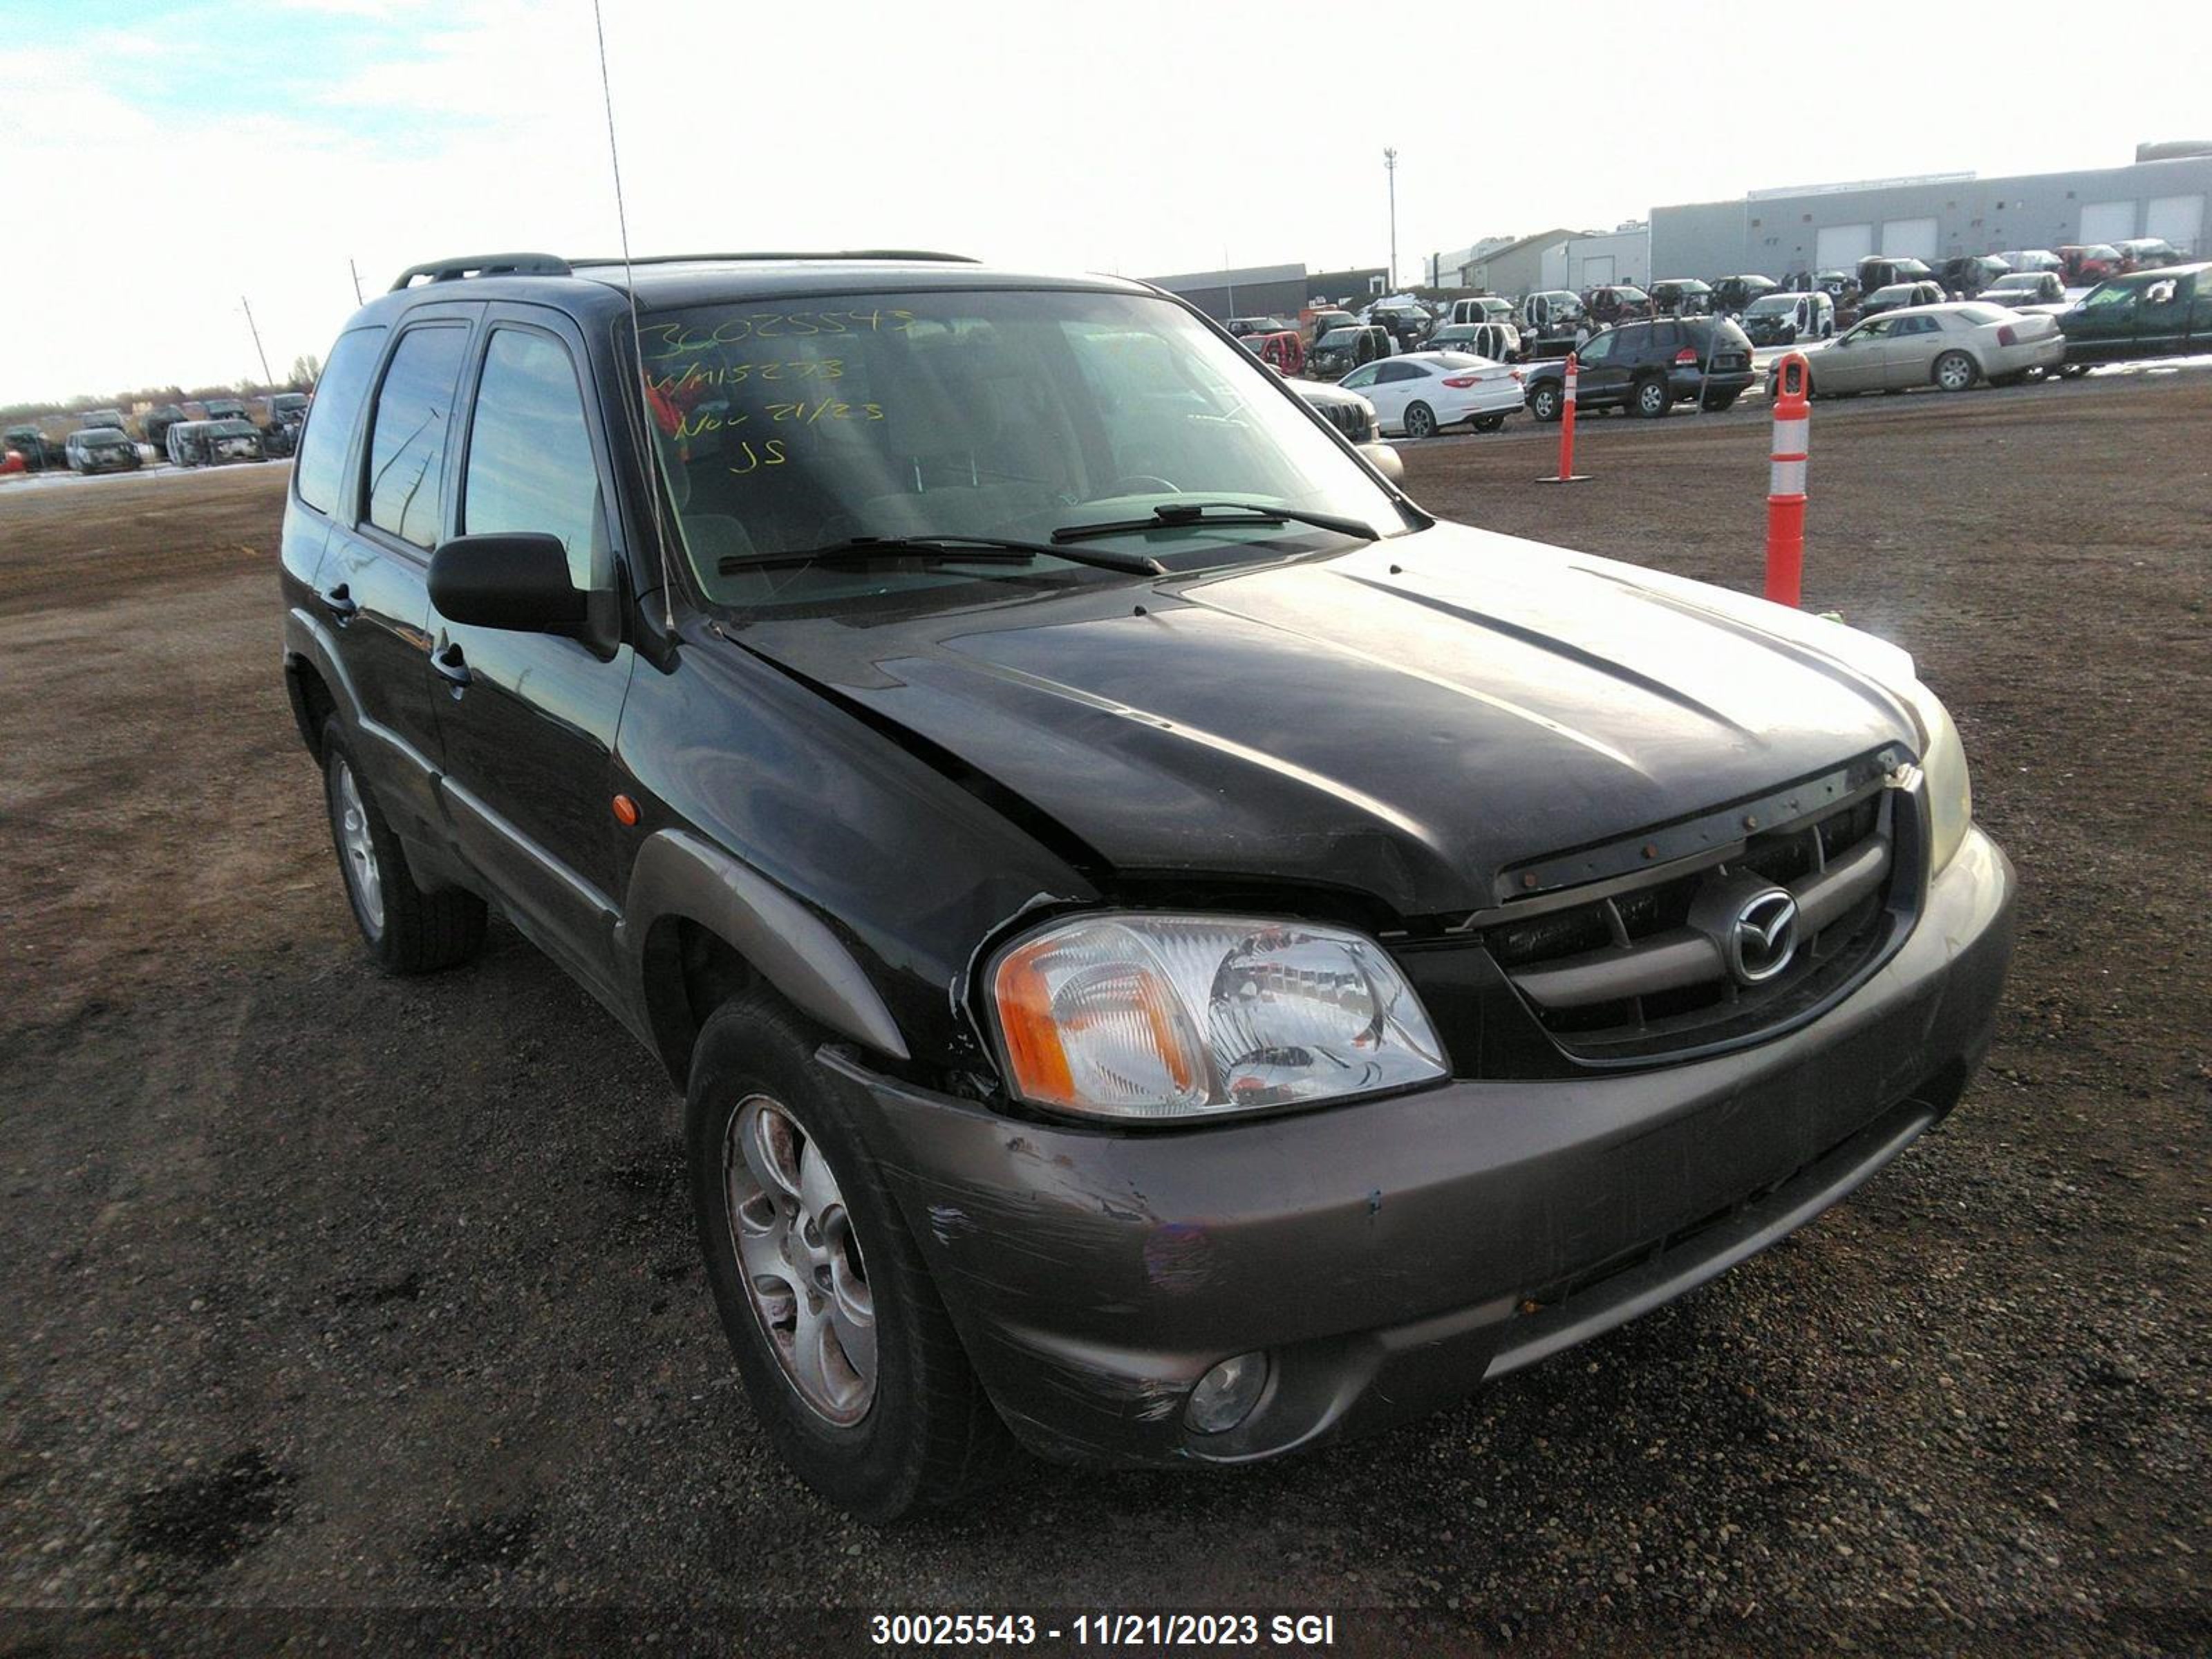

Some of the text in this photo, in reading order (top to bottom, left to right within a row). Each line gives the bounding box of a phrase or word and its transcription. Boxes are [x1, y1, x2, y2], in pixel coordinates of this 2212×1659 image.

[637, 309, 916, 360] 30025543
[765, 397, 885, 425] 21/23
[729, 440, 786, 474] JS
